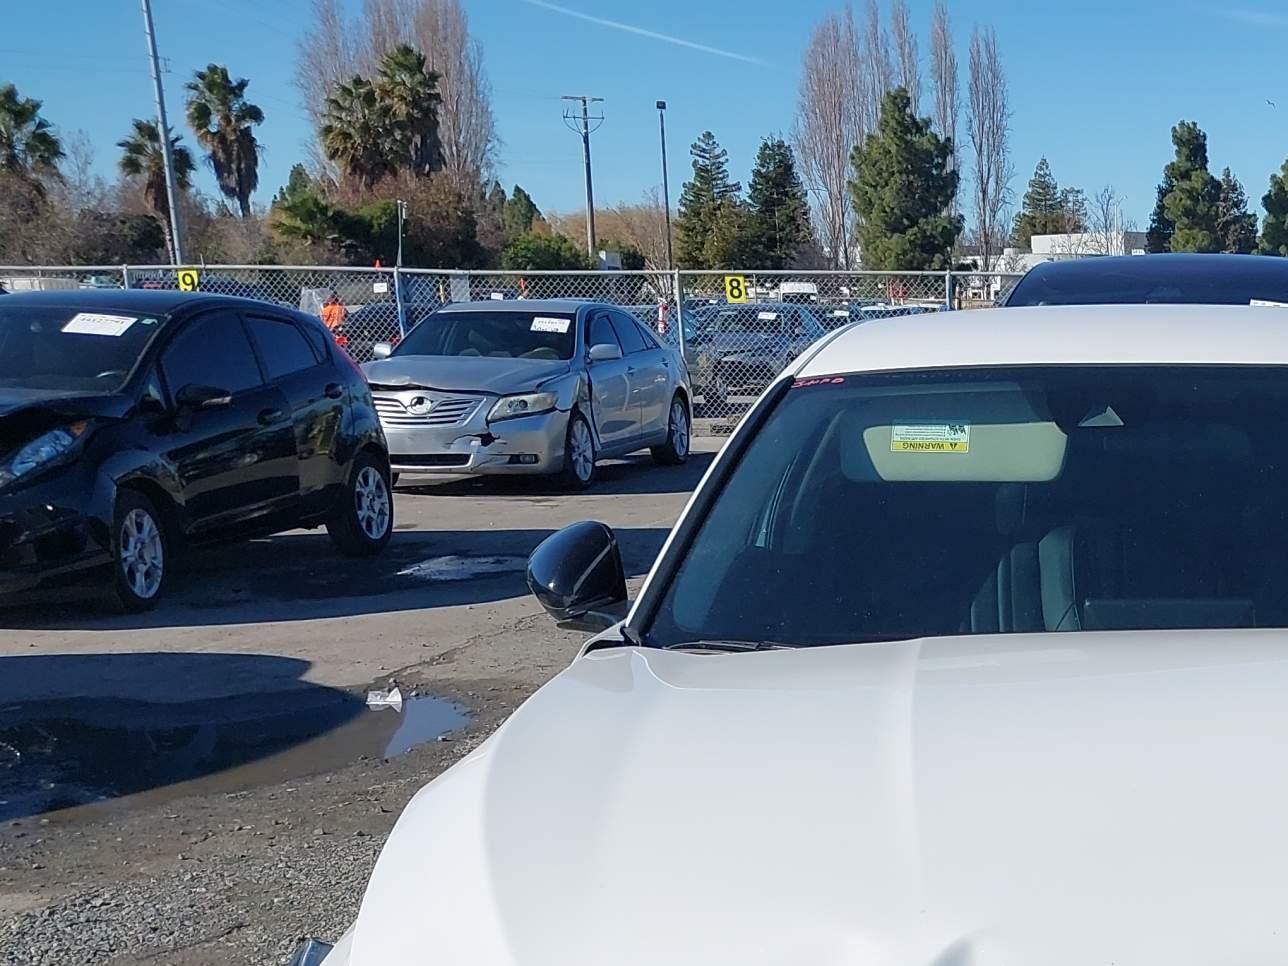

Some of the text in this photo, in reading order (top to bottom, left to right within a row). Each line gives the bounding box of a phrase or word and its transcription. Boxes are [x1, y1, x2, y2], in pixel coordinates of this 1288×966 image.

[181, 272, 195, 290] 9
[729, 278, 742, 299] 8
[902, 442, 945, 450] WARNING
